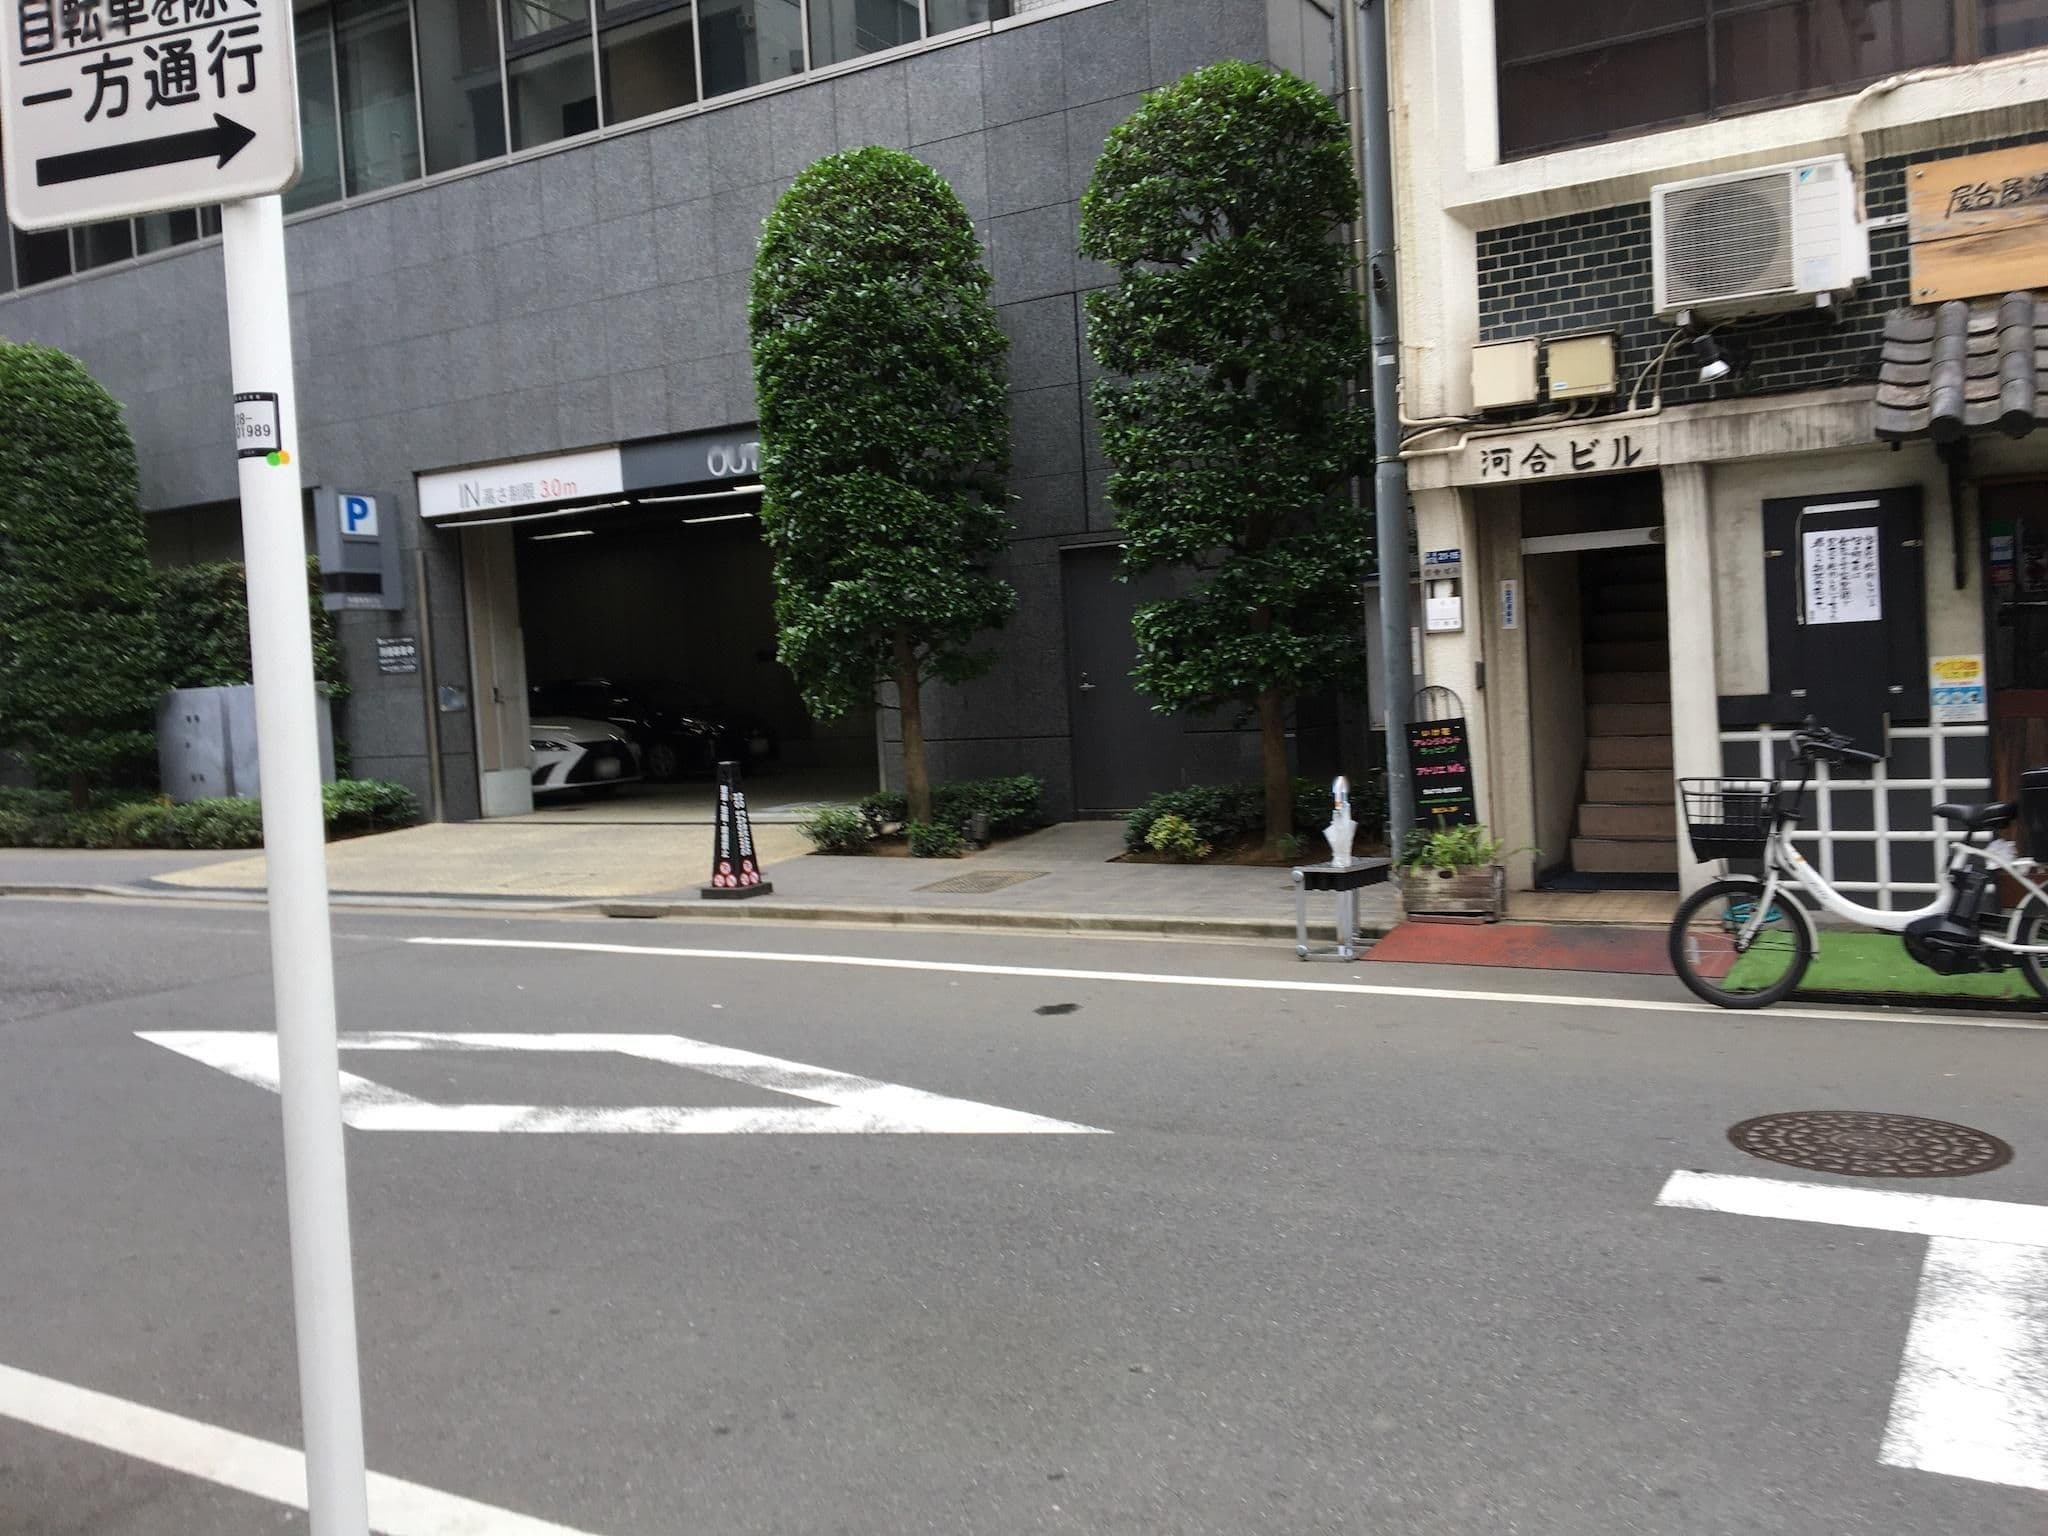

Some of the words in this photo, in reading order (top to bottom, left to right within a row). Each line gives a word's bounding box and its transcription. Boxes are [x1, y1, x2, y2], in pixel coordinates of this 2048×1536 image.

[19, 0, 258, 55] 自転車を
[22, 25, 263, 123] 一方通行
[706, 441, 761, 477] OUT
[1481, 434, 1643, 478] 河合ビル
[345, 496, 369, 532] P
[459, 481, 481, 509] IN
